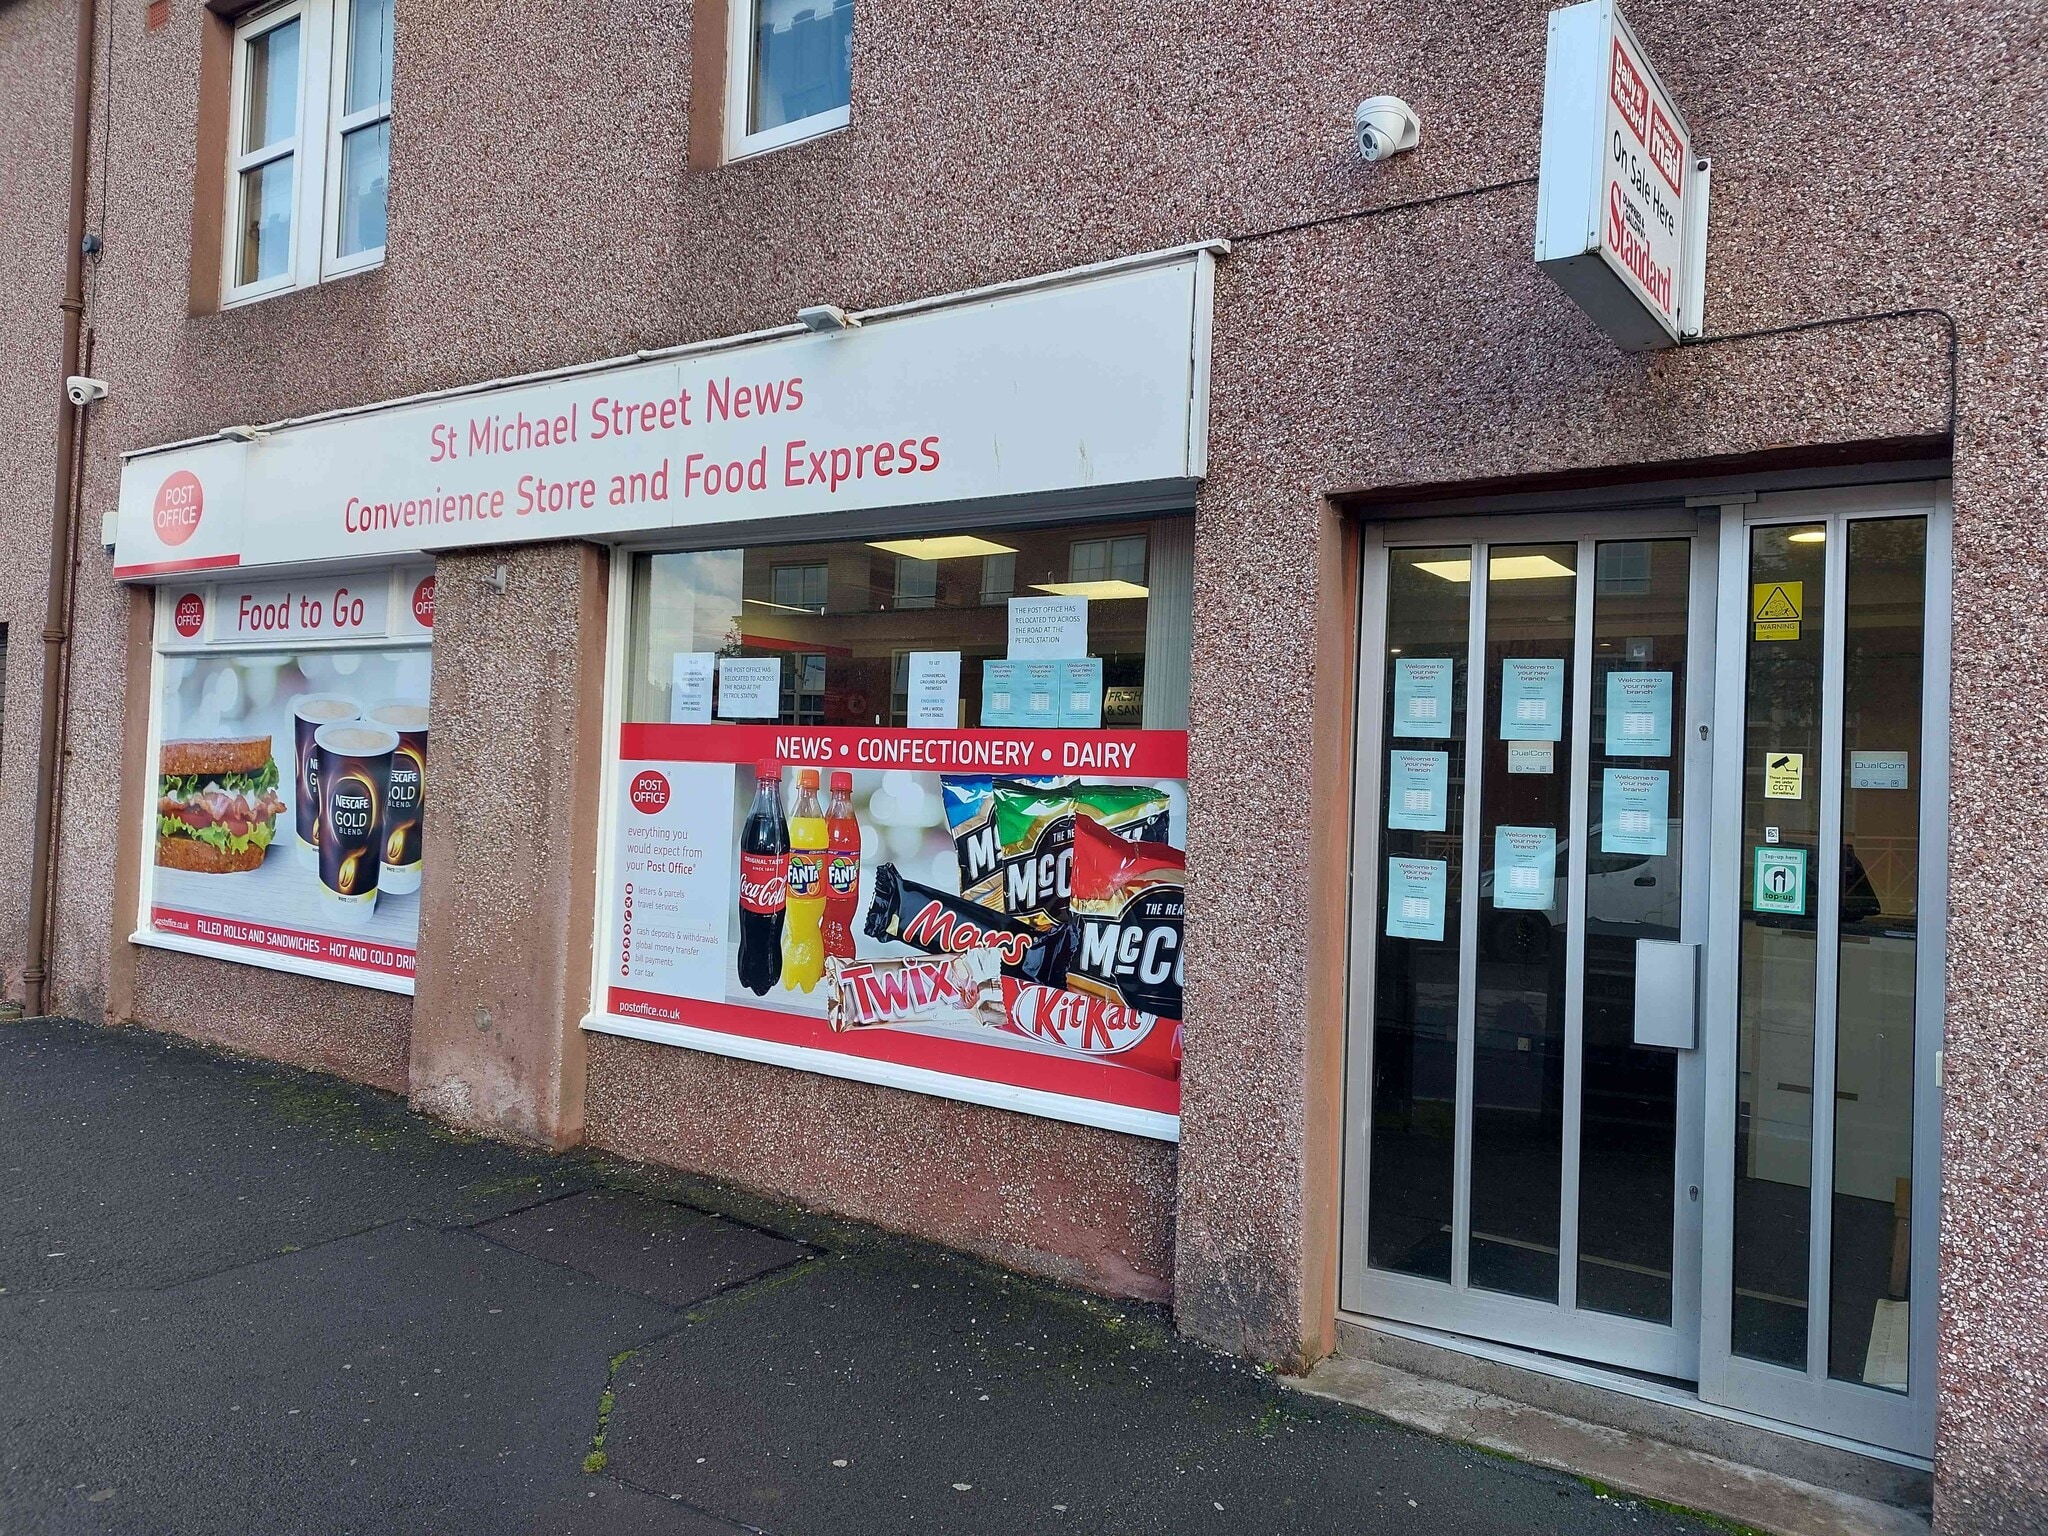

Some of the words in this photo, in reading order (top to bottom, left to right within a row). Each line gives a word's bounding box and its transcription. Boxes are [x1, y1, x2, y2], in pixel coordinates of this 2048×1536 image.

[1616, 48, 1637, 103] Daily
[1615, 72, 1645, 139] Record
[1652, 129, 1680, 187] mail
[1614, 130, 1628, 174] On
[1631, 155, 1650, 206] Sale
[1653, 185, 1674, 237] Here
[1623, 192, 1642, 224] DUMFRIES
[1626, 209, 1647, 243] GALLOWAY
[1609, 180, 1672, 315] Standard
[430, 424, 457, 462] St
[468, 403, 577, 457] Michael
[590, 388, 691, 439] Street
[706, 377, 804, 423] News
[345, 485, 504, 533] Convenience
[516, 475, 595, 515] Store
[609, 457, 669, 506] and
[685, 445, 767, 498] Food
[785, 436, 940, 493] Express
[165, 484, 195, 507] POST
[157, 505, 197, 529] OFFICE
[182, 603, 200, 614] POST
[238, 593, 291, 631] Food
[300, 599, 322, 628] to
[333, 588, 364, 627] Go
[1043, 606, 1063, 614] OFFICE
[1064, 605, 1076, 613] HAS
[177, 614, 201, 627] OFFICE
[1037, 636, 1060, 644] STATION
[1108, 691, 1142, 702] FRESH
[1108, 705, 1115, 716] &
[775, 736, 833, 761] NEWS
[857, 738, 1035, 766] CONFECTIONERY
[1063, 742, 1137, 769] DAIRY
[391, 770, 418, 783] ESCAFE
[639, 779, 663, 791] POST
[388, 786, 416, 800] OLD
[633, 792, 666, 804] OFFICE
[335, 811, 367, 827] GOLD
[339, 828, 362, 836] BLEND
[628, 827, 671, 841] everything
[672, 831, 688, 842] you
[1053, 832, 1065, 842] THE
[627, 844, 651, 855] would
[653, 846, 680, 858] expect
[682, 846, 703, 858] from
[626, 861, 645, 872] your
[647, 860, 666, 873] Post
[668, 862, 693, 875] Office
[744, 856, 768, 865] ORIGINAL
[788, 864, 820, 884] FANTA
[638, 886, 657, 896] letters
[658, 888, 663, 896] &
[664, 890, 685, 899] parcels
[1765, 893, 1794, 902] top-up
[638, 901, 654, 909] travel
[655, 903, 679, 912] services
[1146, 903, 1162, 916] THE
[636, 928, 650, 936] cash
[651, 930, 675, 940] deposits
[677, 931, 681, 940] &
[682, 933, 719, 945] withdrawals
[903, 901, 1031, 965] Mars
[198, 920, 222, 936] FILLED
[224, 924, 247, 940] ROLLS
[248, 929, 265, 944] AND
[267, 932, 320, 953] SANDWICHES
[330, 943, 348, 958] HOT
[349, 946, 368, 962] AND
[370, 949, 394, 967] COLD
[636, 941, 653, 951] global
[654, 944, 674, 954] money
[676, 946, 700, 956] transfer
[635, 954, 644, 962] bill
[645, 956, 674, 967] payments
[634, 968, 644, 976] car
[644, 969, 655, 977] tax
[619, 1001, 681, 1020] postoffice.co.uk
